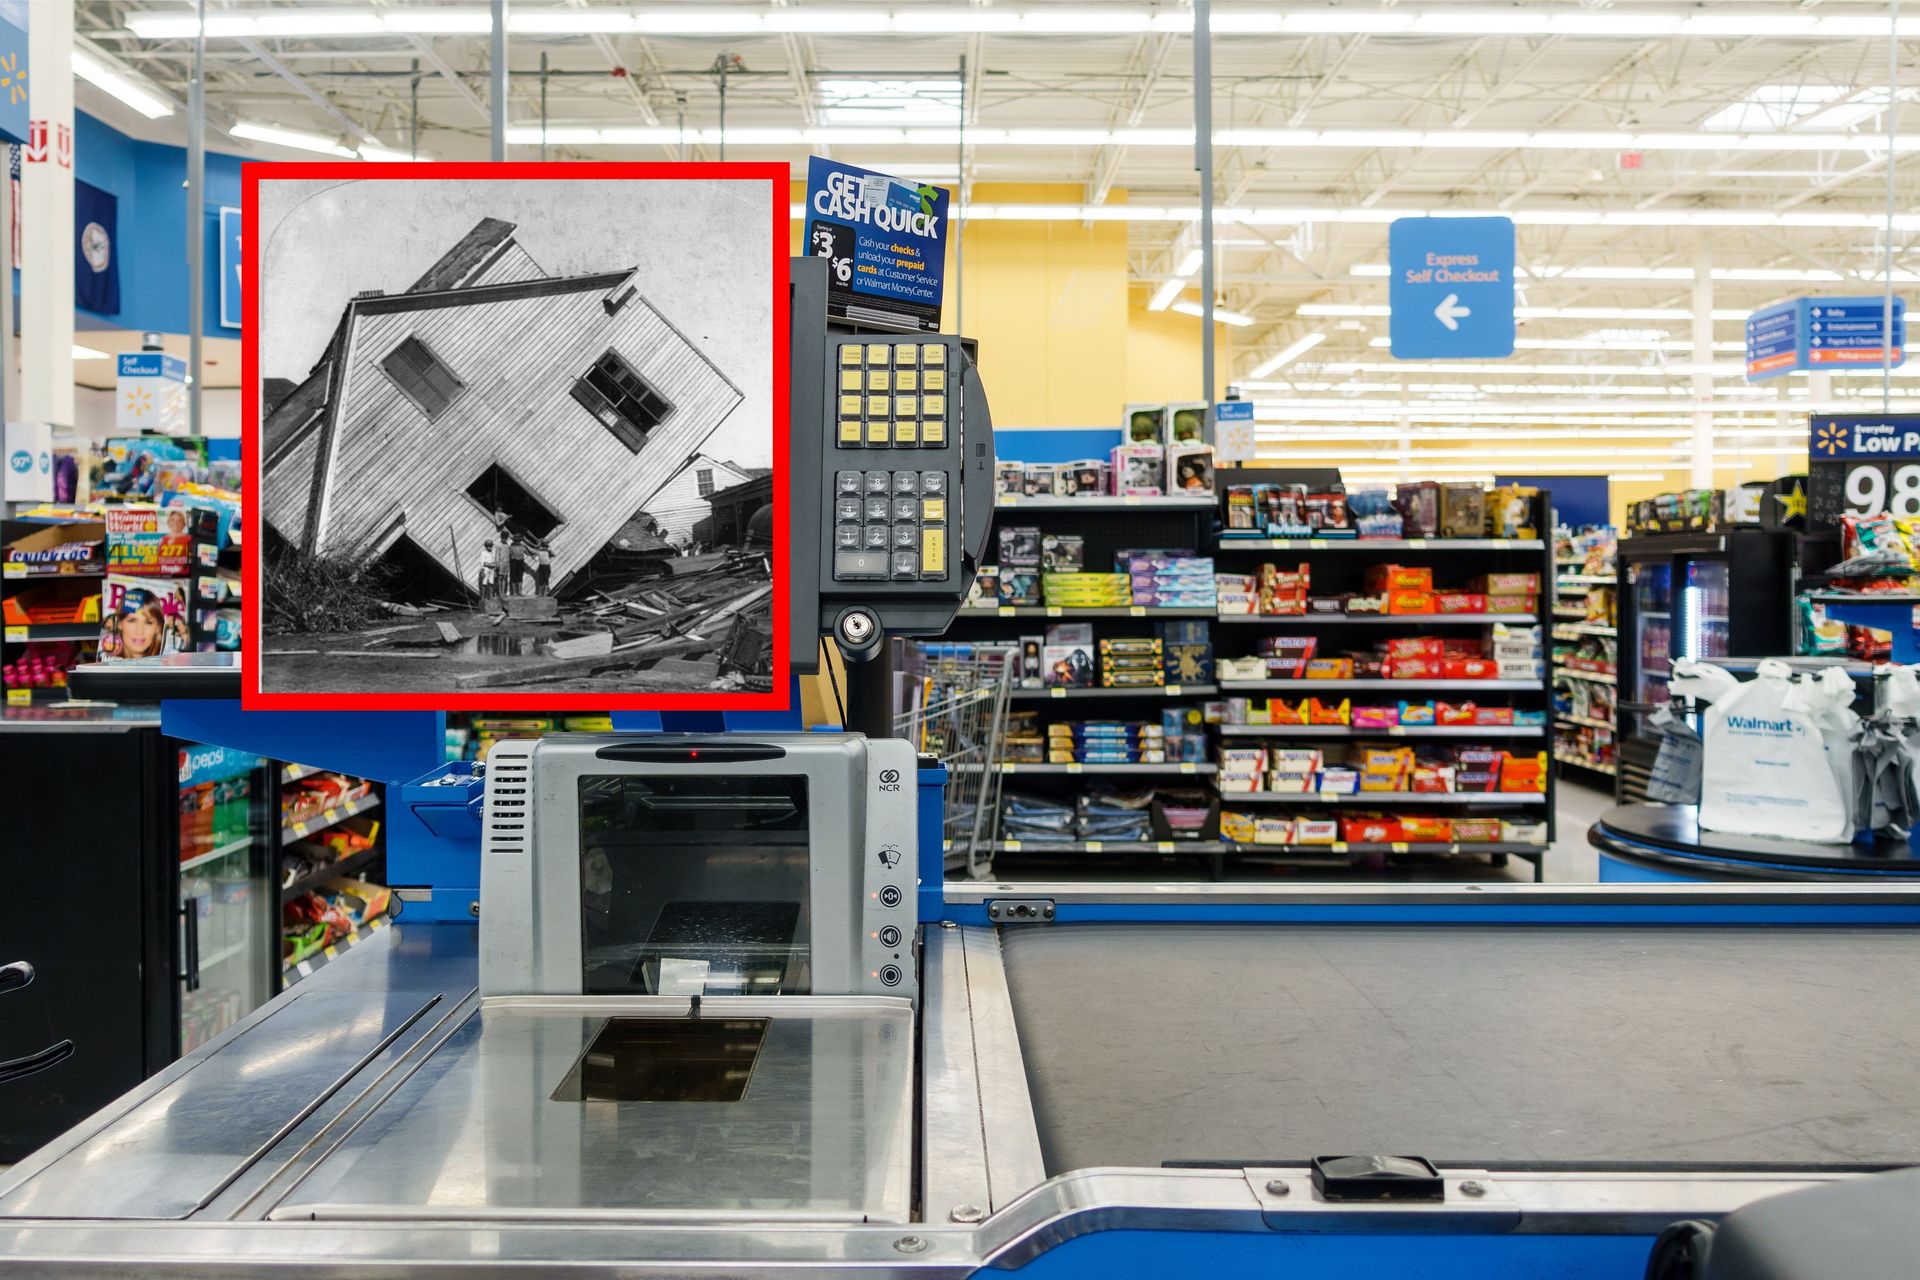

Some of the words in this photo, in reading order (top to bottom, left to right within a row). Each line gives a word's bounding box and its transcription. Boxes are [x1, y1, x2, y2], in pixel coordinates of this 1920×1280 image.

[827, 172, 869, 202] GET
[814, 190, 871, 224] CASH
[874, 204, 939, 239] QUICK
[858, 236, 875, 248] Cash
[874, 240, 891, 252] your
[890, 243, 915, 256] checks
[914, 247, 921, 257] &
[858, 251, 881, 262] unload
[881, 255, 895, 266] your
[896, 259, 925, 271] prepaid
[1426, 252, 1479, 268] Express
[857, 263, 878, 275] cards
[877, 267, 885, 275] at
[884, 269, 916, 282] Customer
[916, 273, 938, 287] Service
[1406, 269, 1431, 284] Self
[1435, 268, 1499, 283] Checkout
[864, 277, 892, 291] Walmart
[123, 366, 158, 375] Checkout
[1854, 424, 1896, 435] Everyday
[1854, 434, 1901, 453] Low
[1904, 432, 1920, 452] P
[847, 478, 853, 486] 7
[875, 478, 881, 486] 8
[902, 478, 909, 486] 9
[846, 505, 852, 513] 4
[874, 504, 881, 512] 5
[902, 505, 909, 513] 6
[874, 532, 881, 541] 2
[902, 532, 908, 540] 3
[161, 544, 184, 557] 277
[858, 559, 865, 567] 0
[1727, 716, 1792, 732] Walmart
[192, 747, 224, 773] pepsi
[878, 784, 901, 792] NCR
